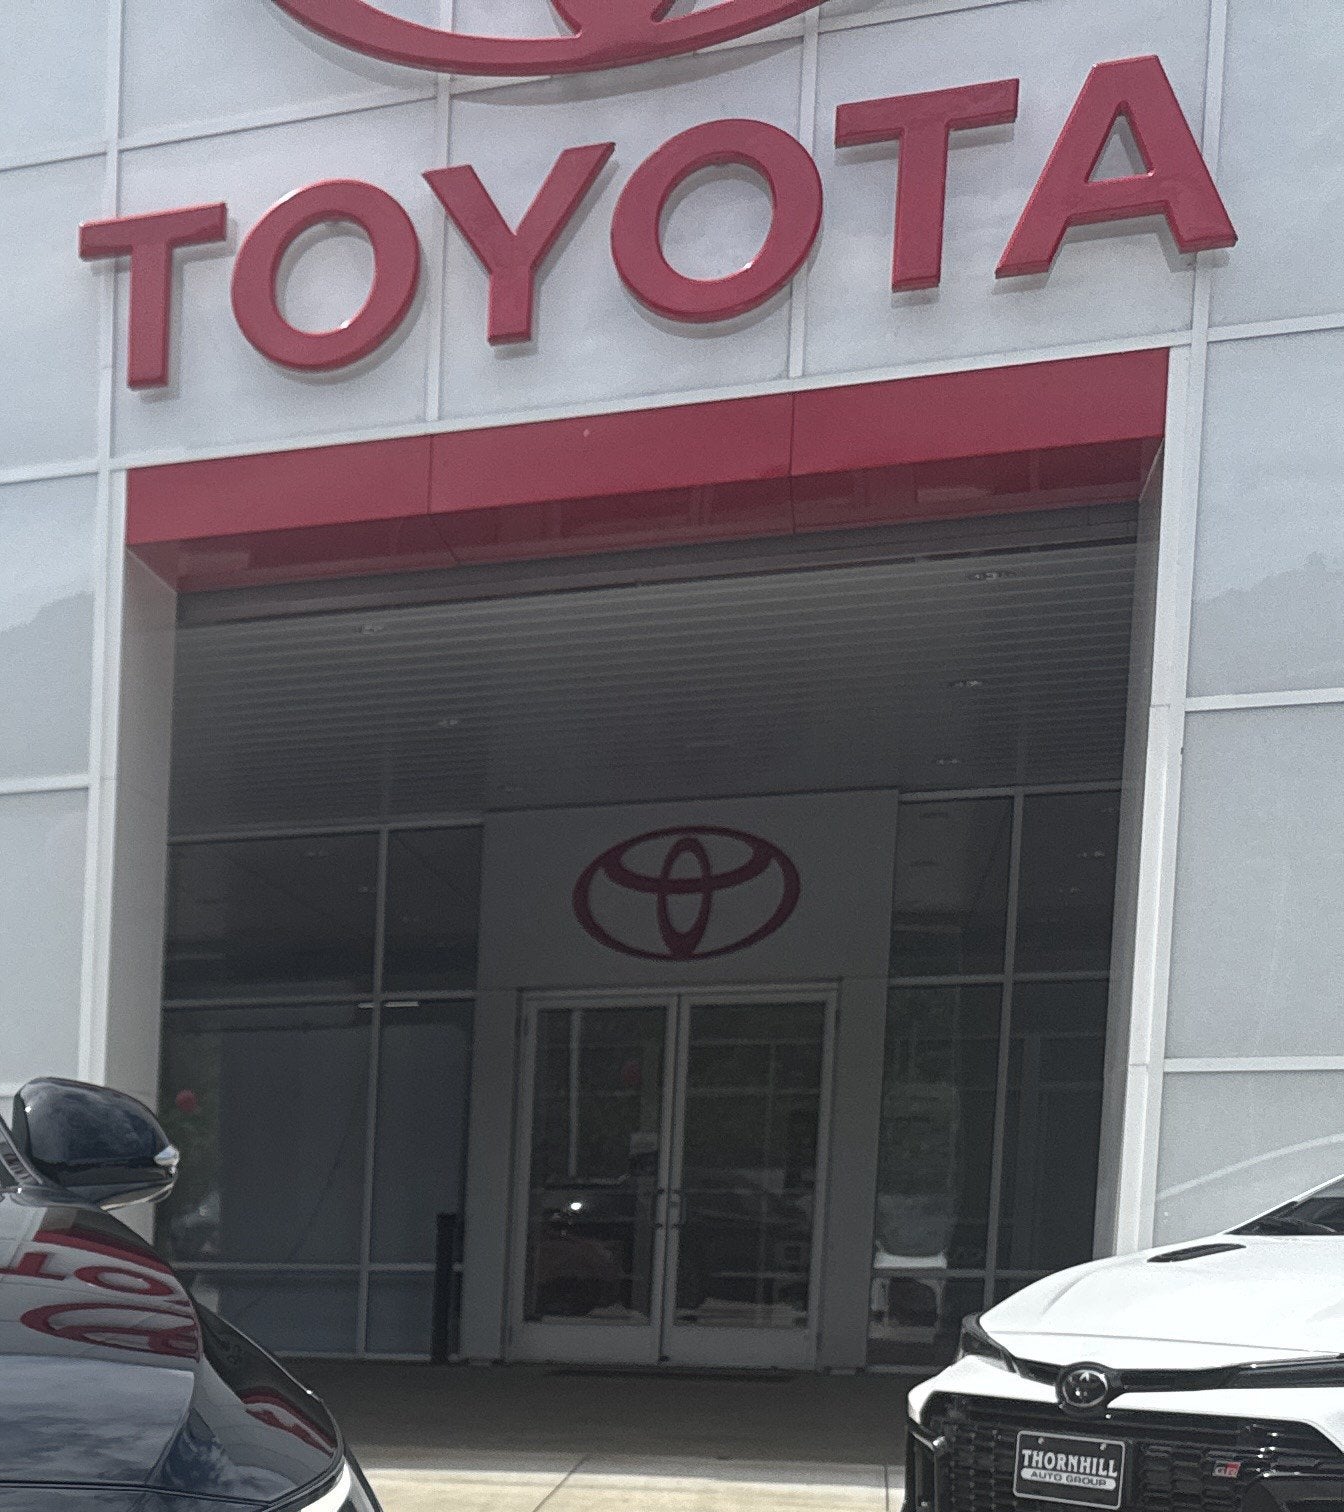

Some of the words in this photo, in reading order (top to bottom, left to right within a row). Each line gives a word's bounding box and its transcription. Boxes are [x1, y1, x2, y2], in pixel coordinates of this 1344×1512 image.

[79, 55, 1239, 389] TOYOTA
[1022, 1449, 1118, 1478] THORNHILL
[1031, 1470, 1063, 1482] AUTO
[1065, 1474, 1107, 1487] GROUP
